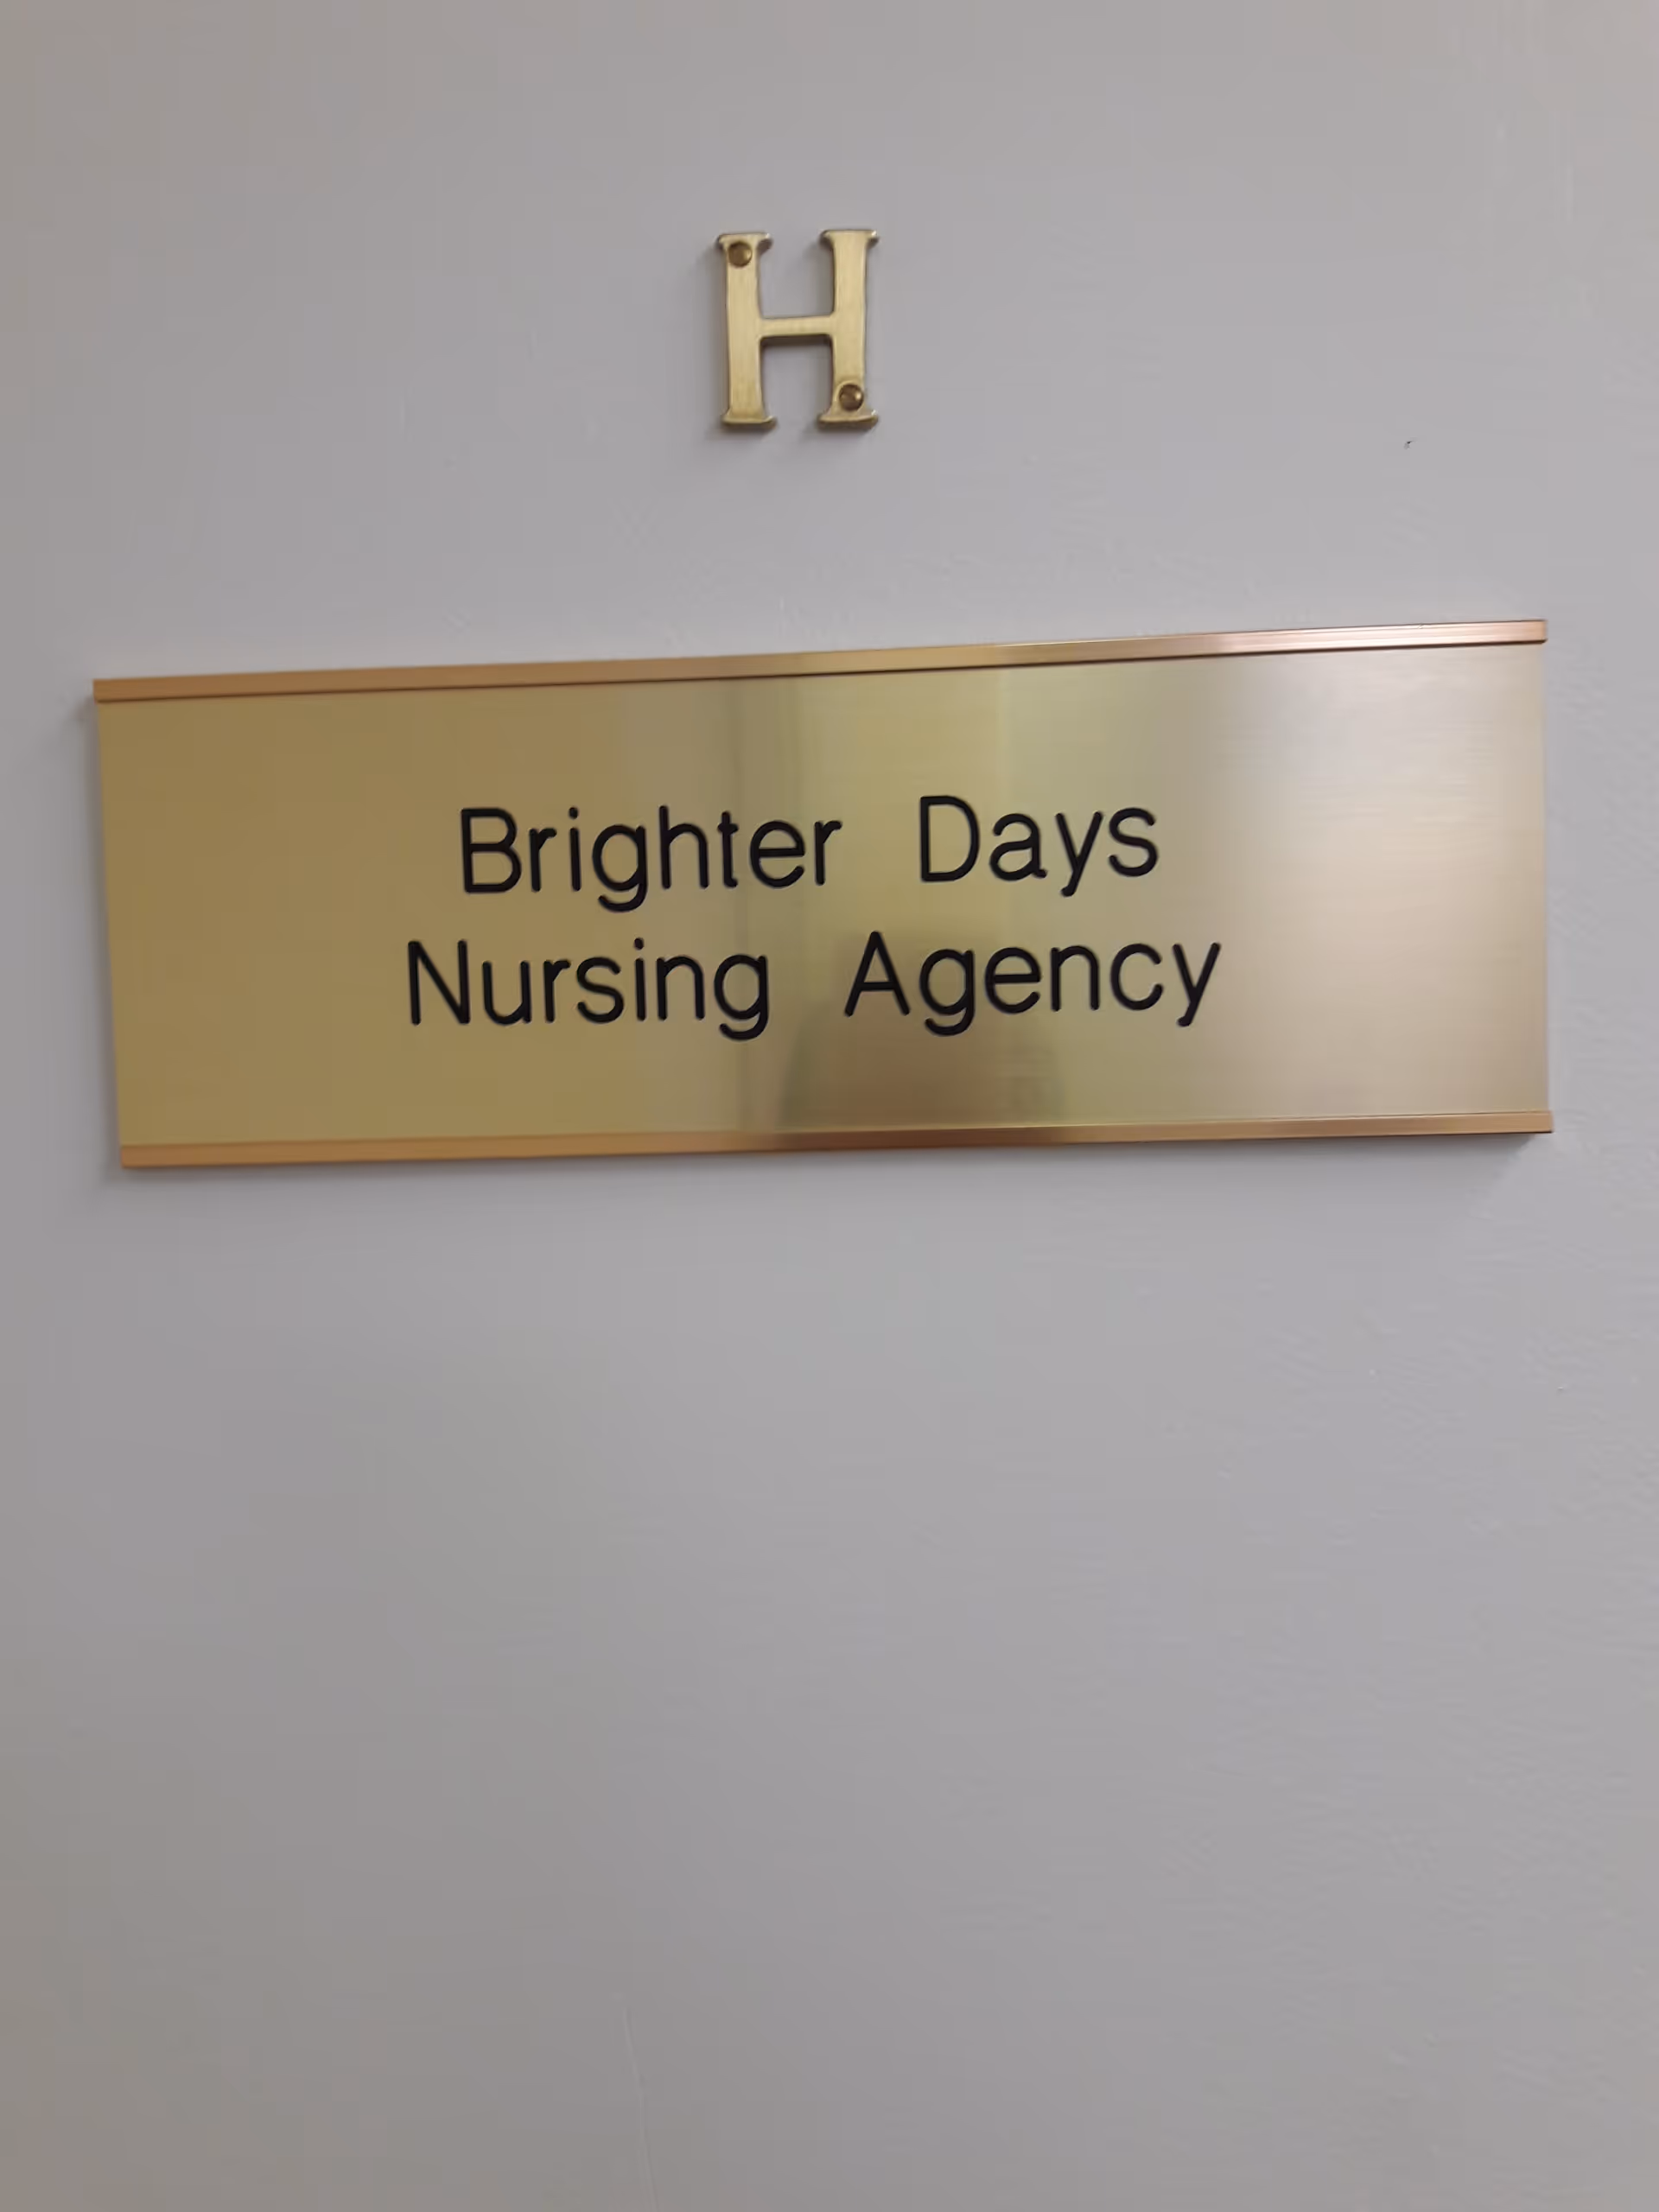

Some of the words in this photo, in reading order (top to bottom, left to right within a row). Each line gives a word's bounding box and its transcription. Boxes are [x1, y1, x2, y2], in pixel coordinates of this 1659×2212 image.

[716, 229, 879, 432] H
[460, 804, 842, 913] Brighter
[919, 795, 1159, 898] Days
[407, 937, 770, 1042] Nursing
[843, 931, 1221, 1038] Agency
